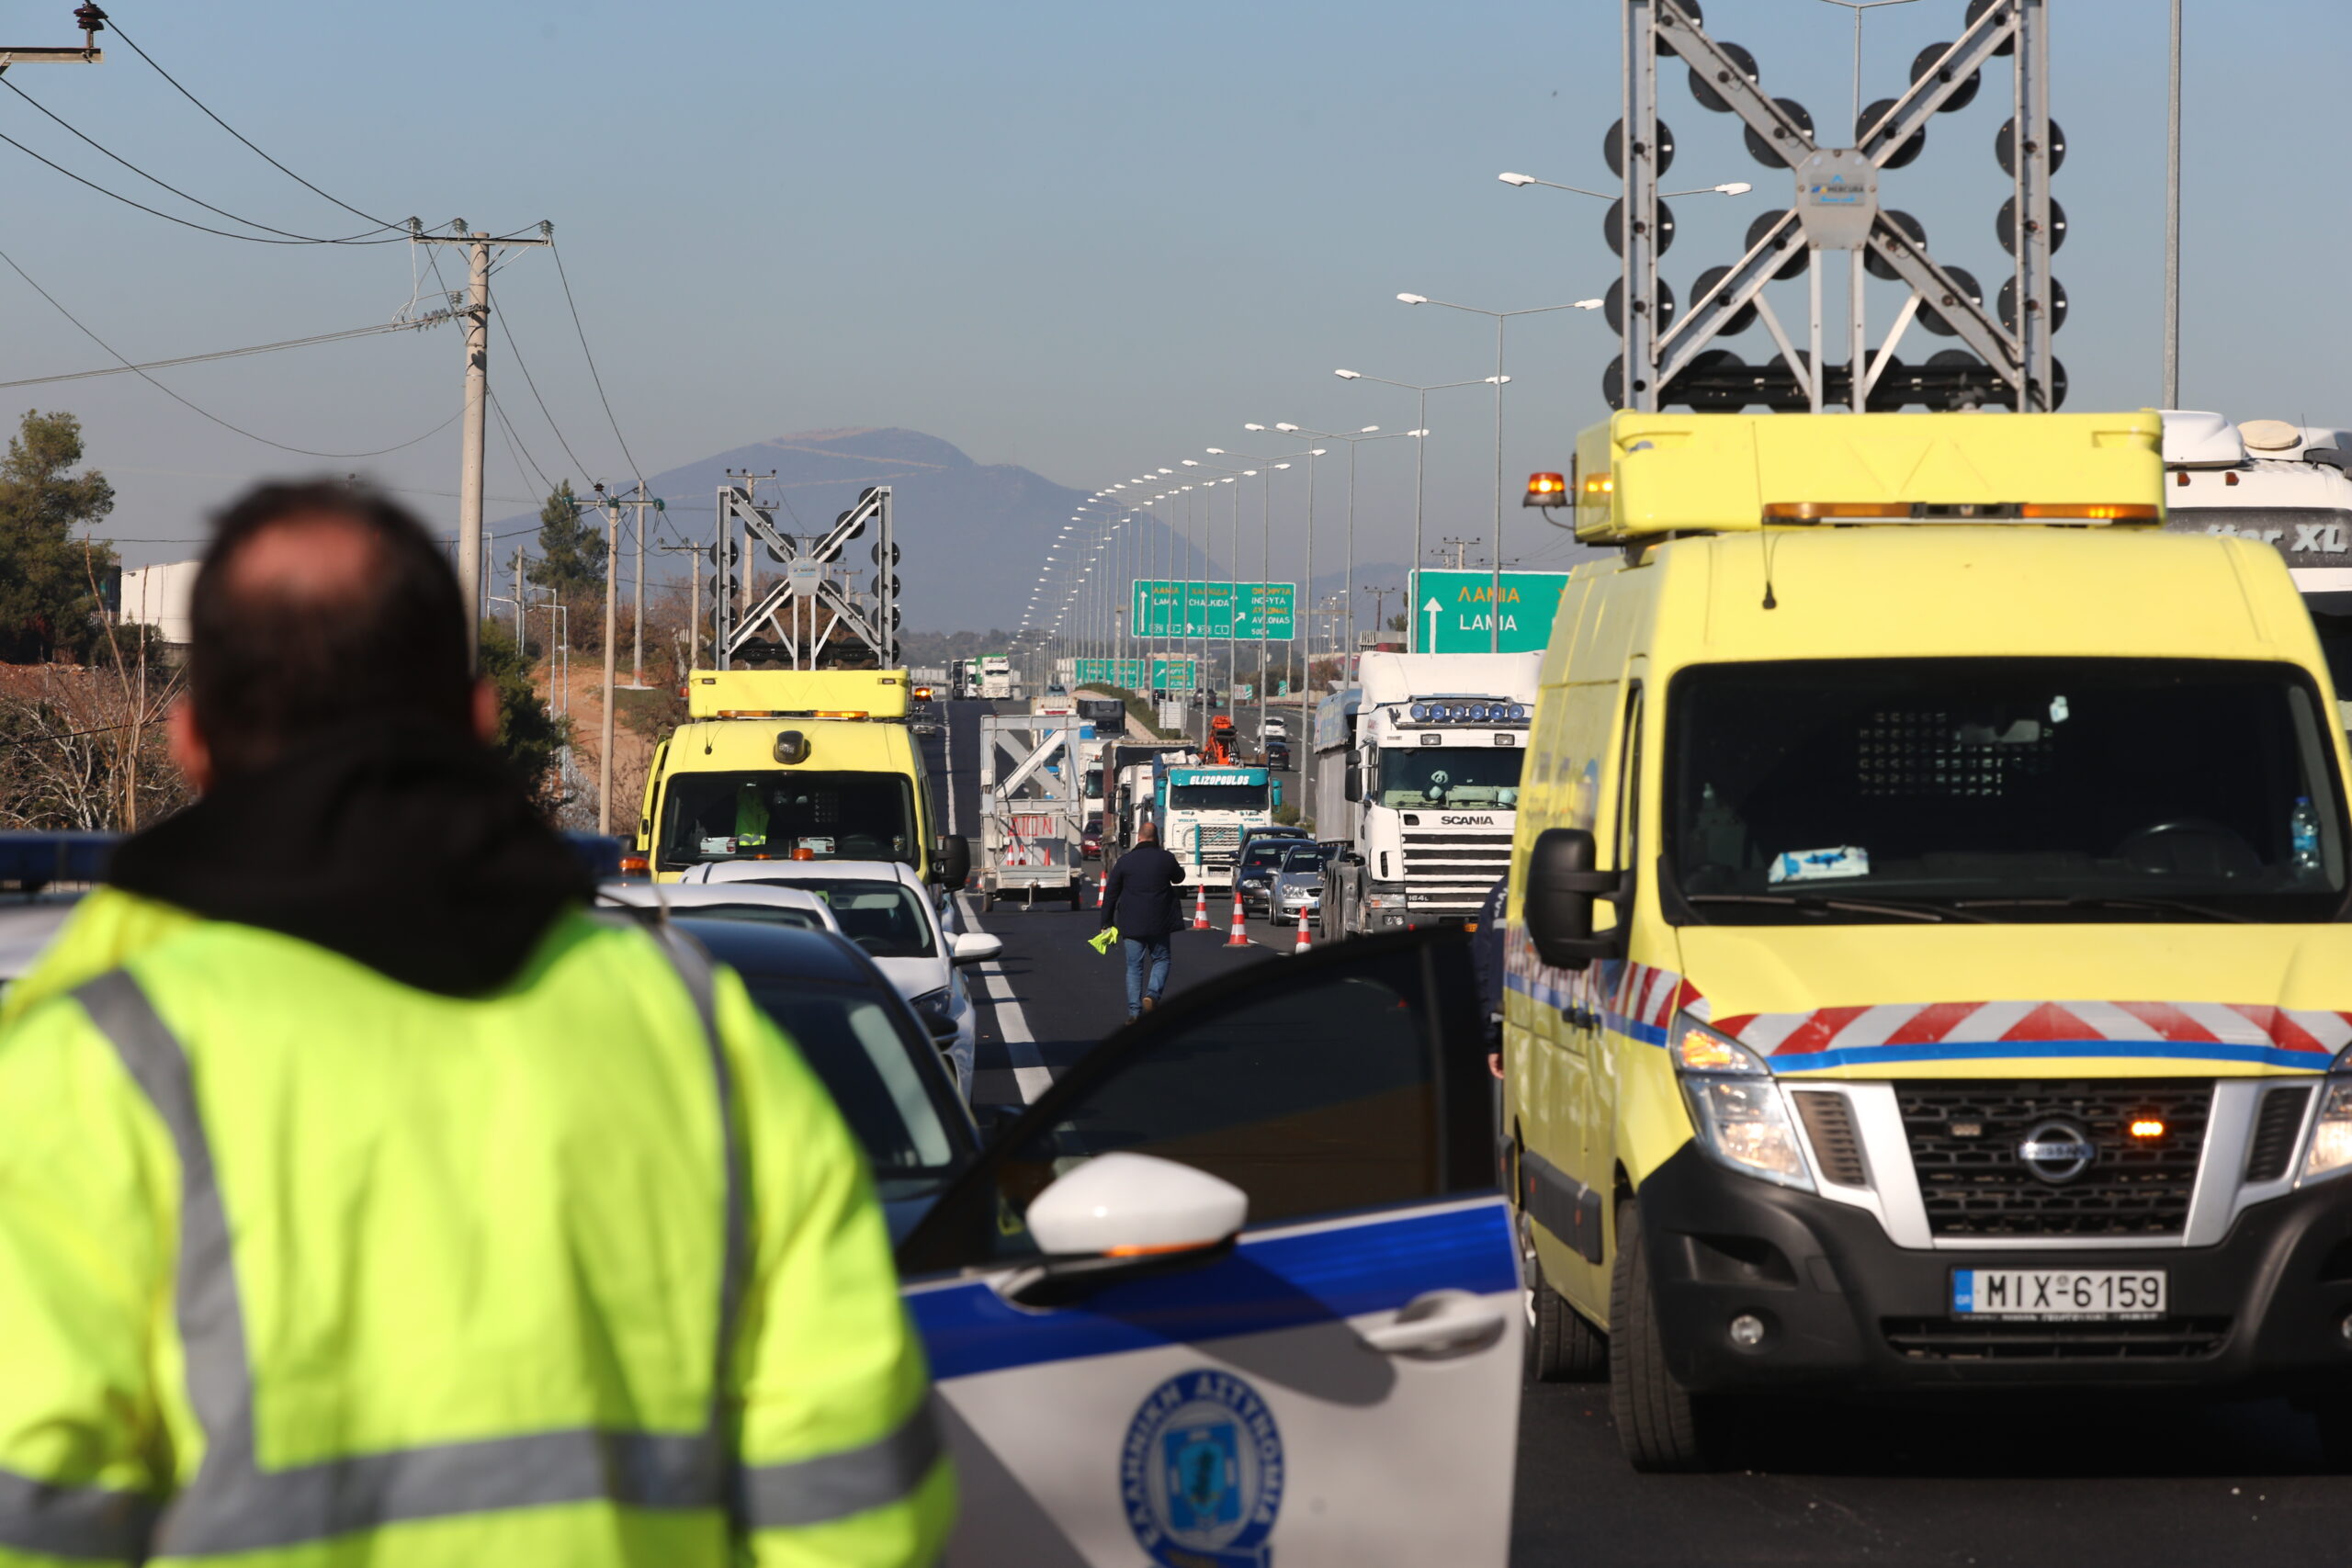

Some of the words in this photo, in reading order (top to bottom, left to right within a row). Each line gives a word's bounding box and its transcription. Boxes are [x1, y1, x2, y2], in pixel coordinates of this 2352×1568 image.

[2290, 524, 2348, 554] XL
[1154, 598, 1178, 606] LAMA
[1459, 614, 1518, 631] LAMIA
[1441, 816, 1494, 825] SCANIA
[1987, 1275, 2159, 1308] MIX-6159
